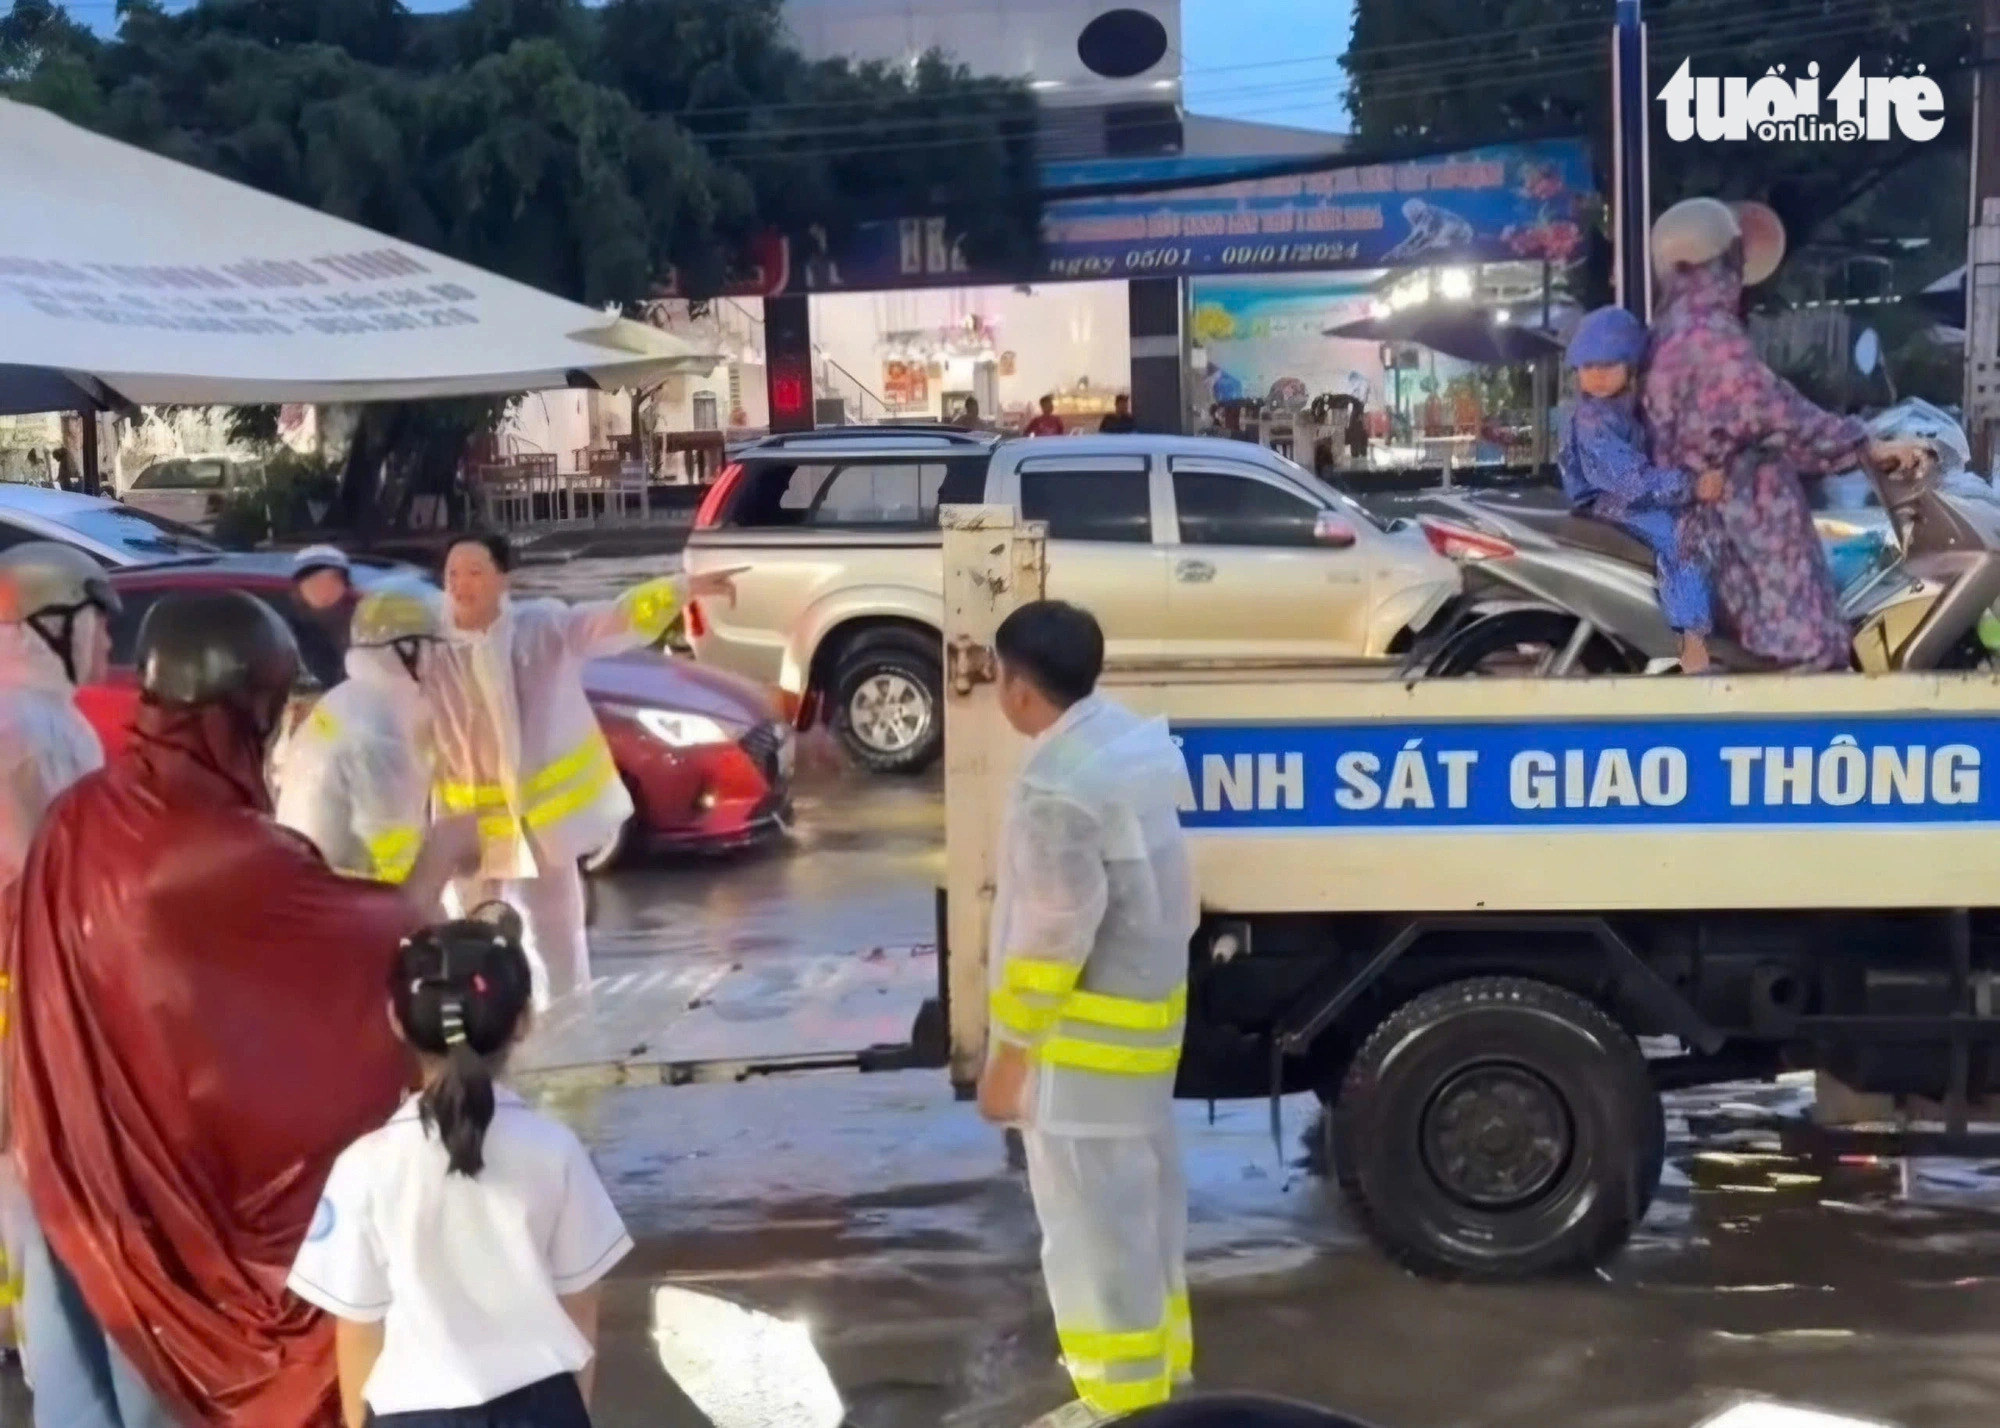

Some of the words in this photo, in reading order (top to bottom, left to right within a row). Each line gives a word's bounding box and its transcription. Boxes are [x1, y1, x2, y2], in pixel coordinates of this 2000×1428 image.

[1168, 735, 1304, 811] ẢNH
[1334, 738, 1479, 810] SÁT
[1510, 746, 1689, 809] GIAO
[1720, 733, 1981, 806] THÔNG
